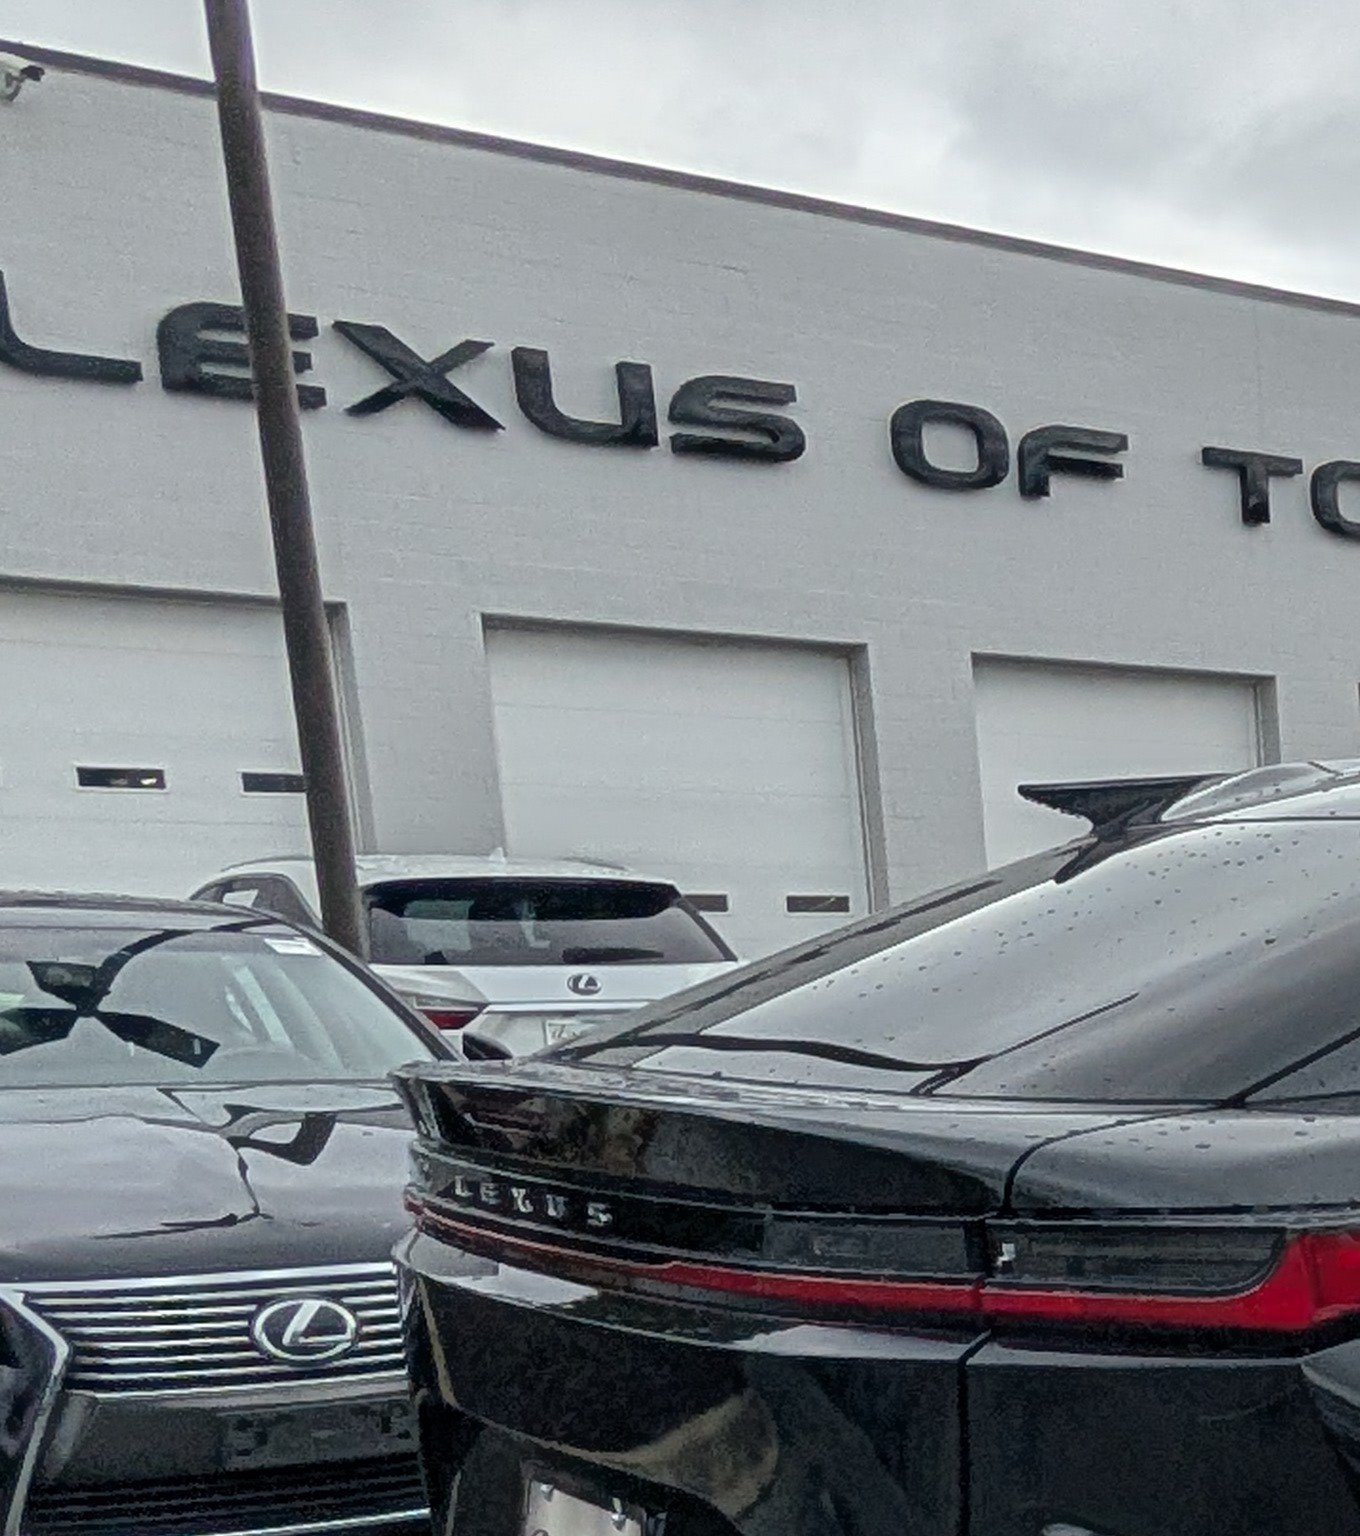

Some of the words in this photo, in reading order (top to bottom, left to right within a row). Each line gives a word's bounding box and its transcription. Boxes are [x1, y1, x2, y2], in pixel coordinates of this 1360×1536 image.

[0, 268, 806, 464] LEXUS
[889, 398, 1130, 498] OF
[453, 1175, 614, 1226] LEXUS
